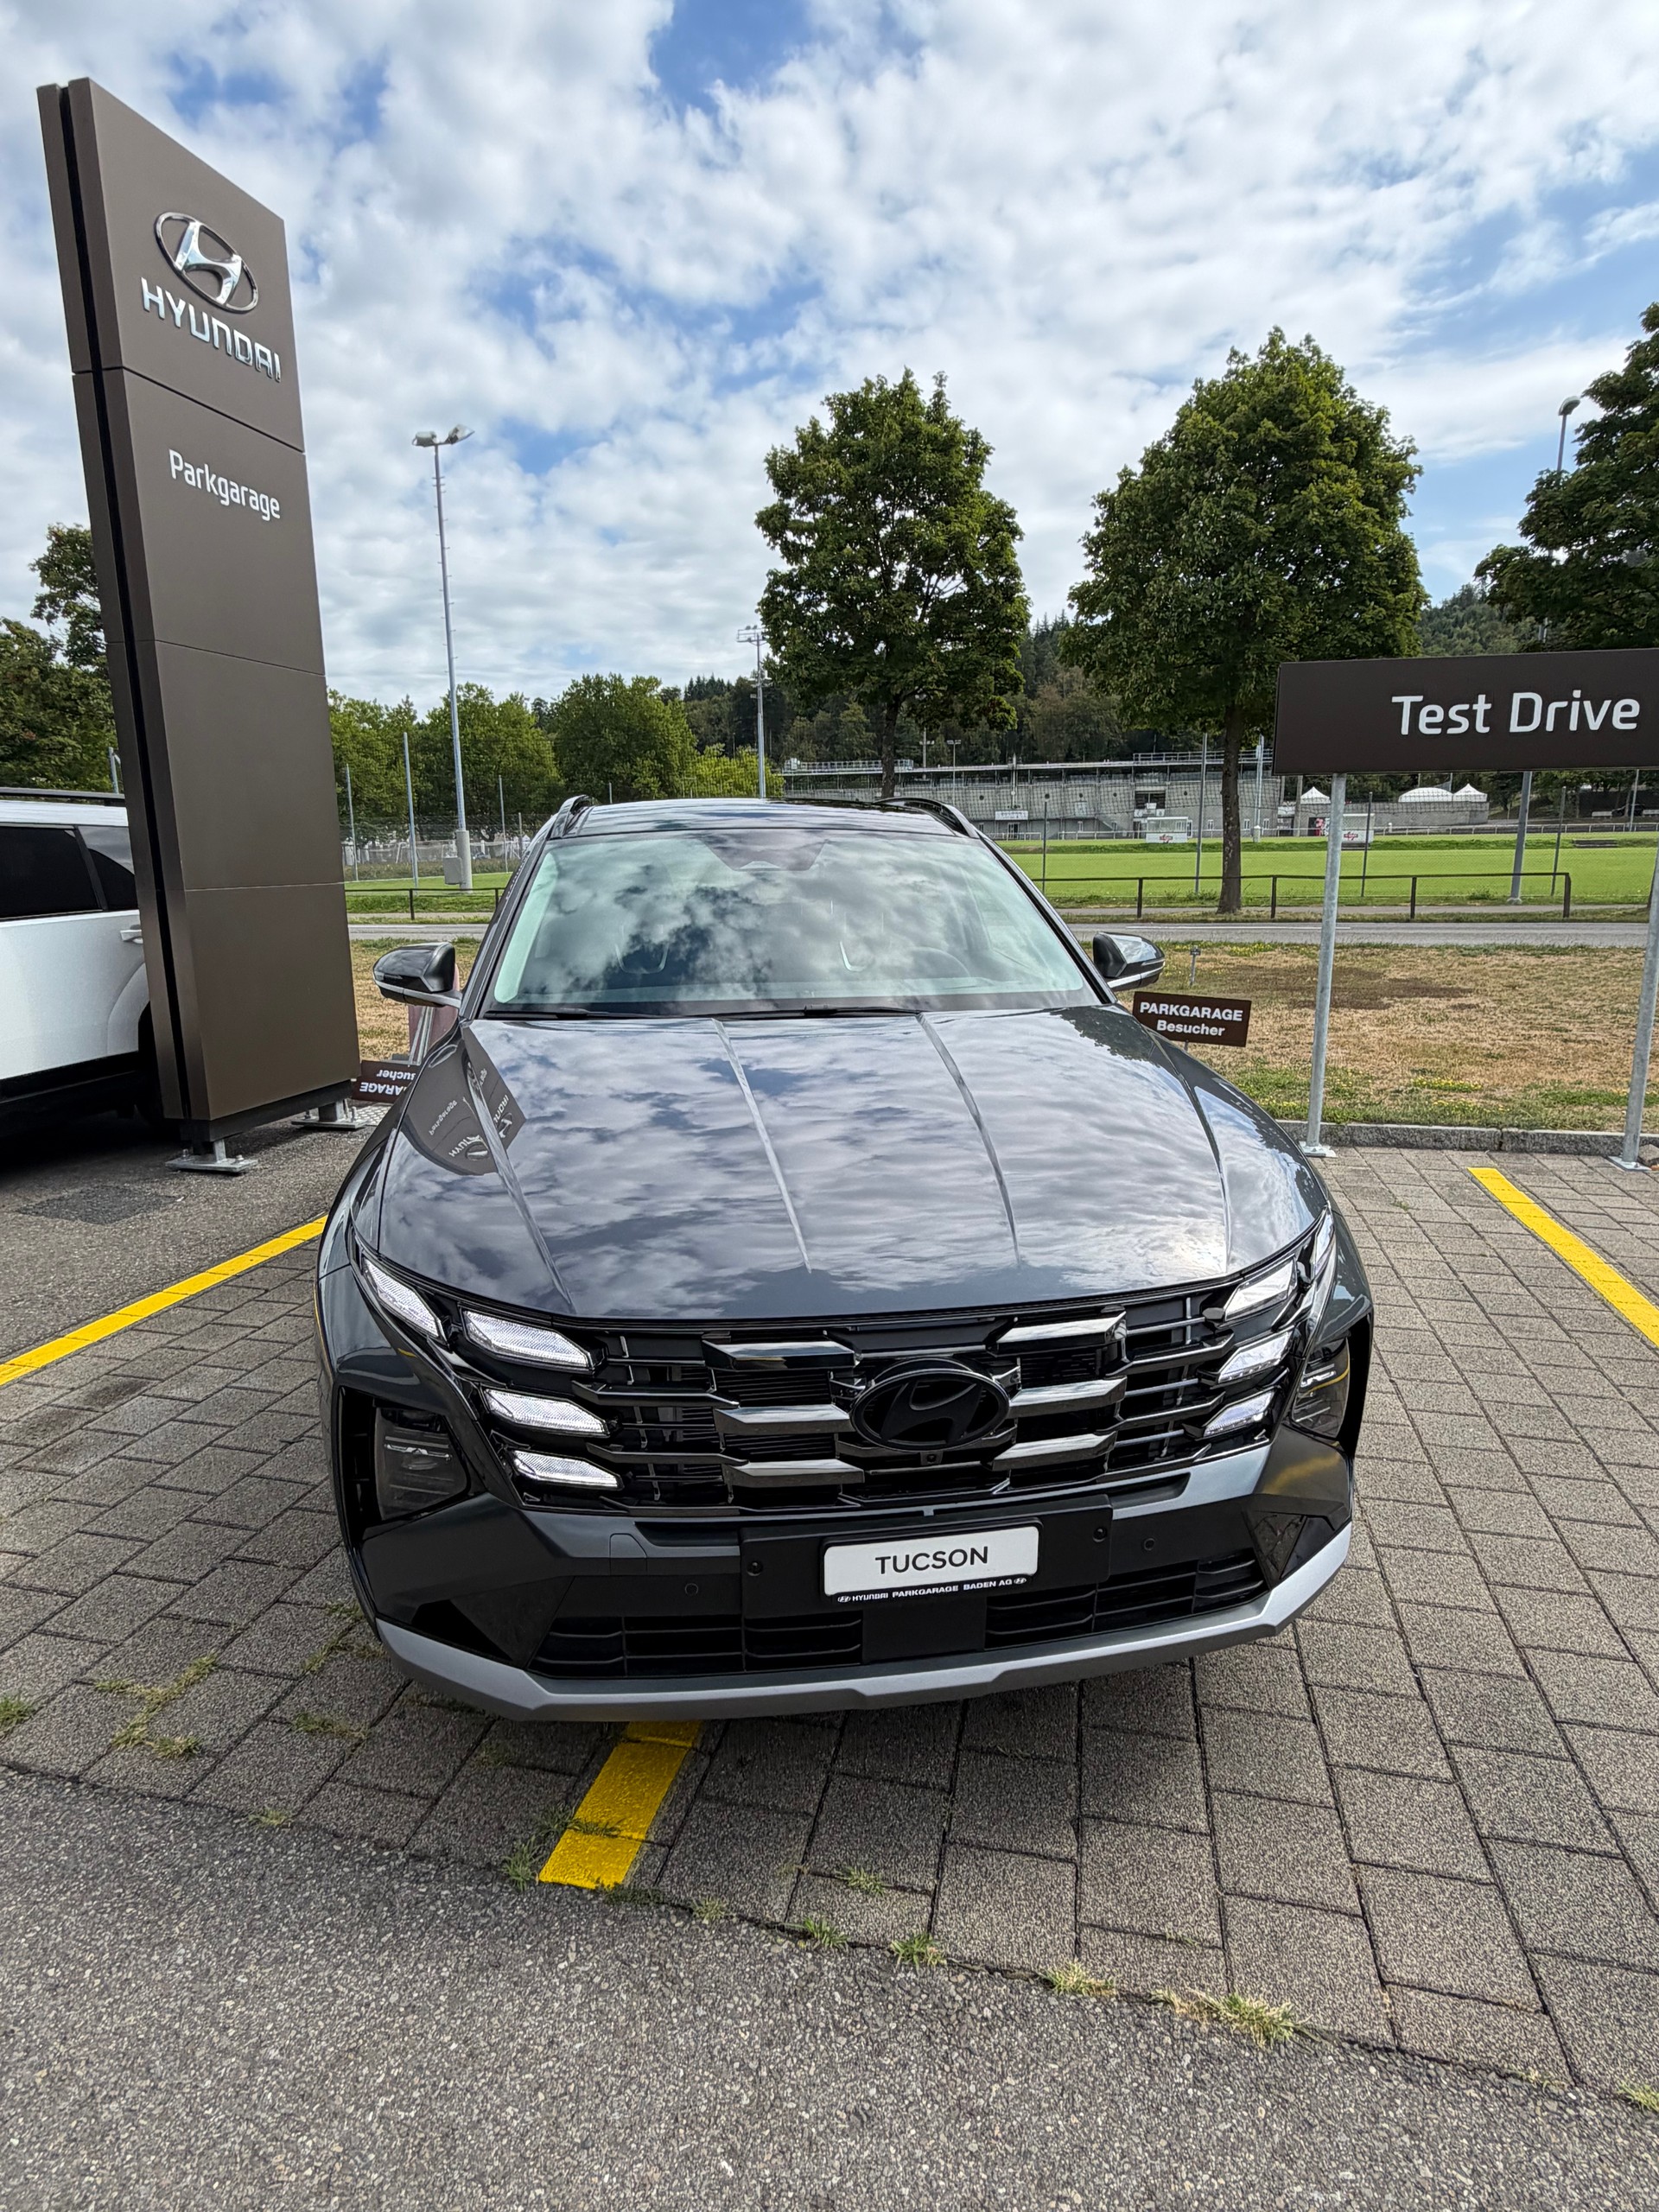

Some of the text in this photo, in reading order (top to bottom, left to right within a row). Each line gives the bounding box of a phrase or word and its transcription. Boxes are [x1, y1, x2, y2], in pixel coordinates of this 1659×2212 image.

[141, 276, 281, 383] HYUNDAI
[169, 448, 280, 521] Parkgarage
[1392, 690, 1641, 735] Test Drive
[1139, 1001, 1243, 1022] PARKGARAGE
[1156, 1019, 1225, 1037] Besucher
[359, 1081, 407, 1096] ARAGE
[874, 1546, 988, 1575] TUCSON
[852, 1579, 1013, 1602] HYUNDAI PARKGARAGE BADEN AG
